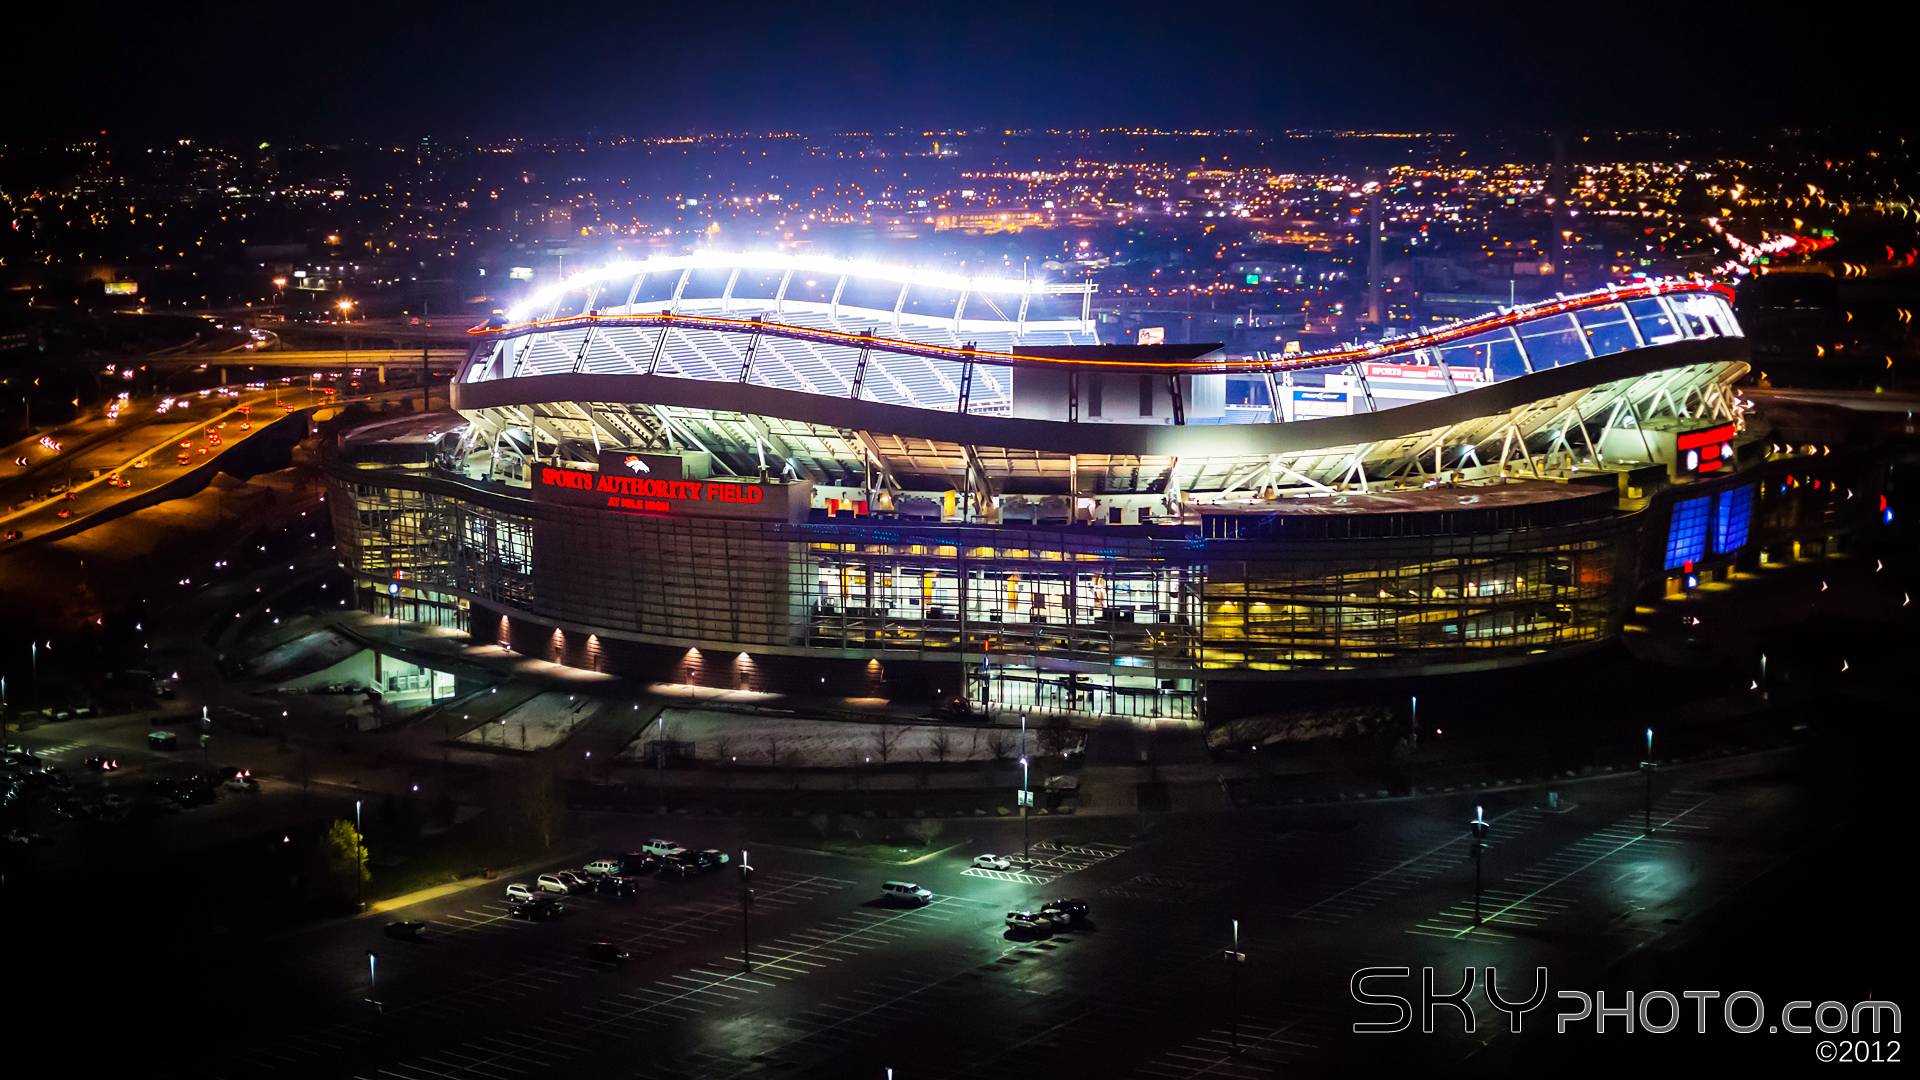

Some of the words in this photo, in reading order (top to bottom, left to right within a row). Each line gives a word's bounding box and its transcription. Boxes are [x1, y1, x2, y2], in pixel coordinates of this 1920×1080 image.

[542, 467, 593, 491] SPORTS
[597, 475, 702, 501] AUTHORITY
[708, 483, 763, 504] FIELD
